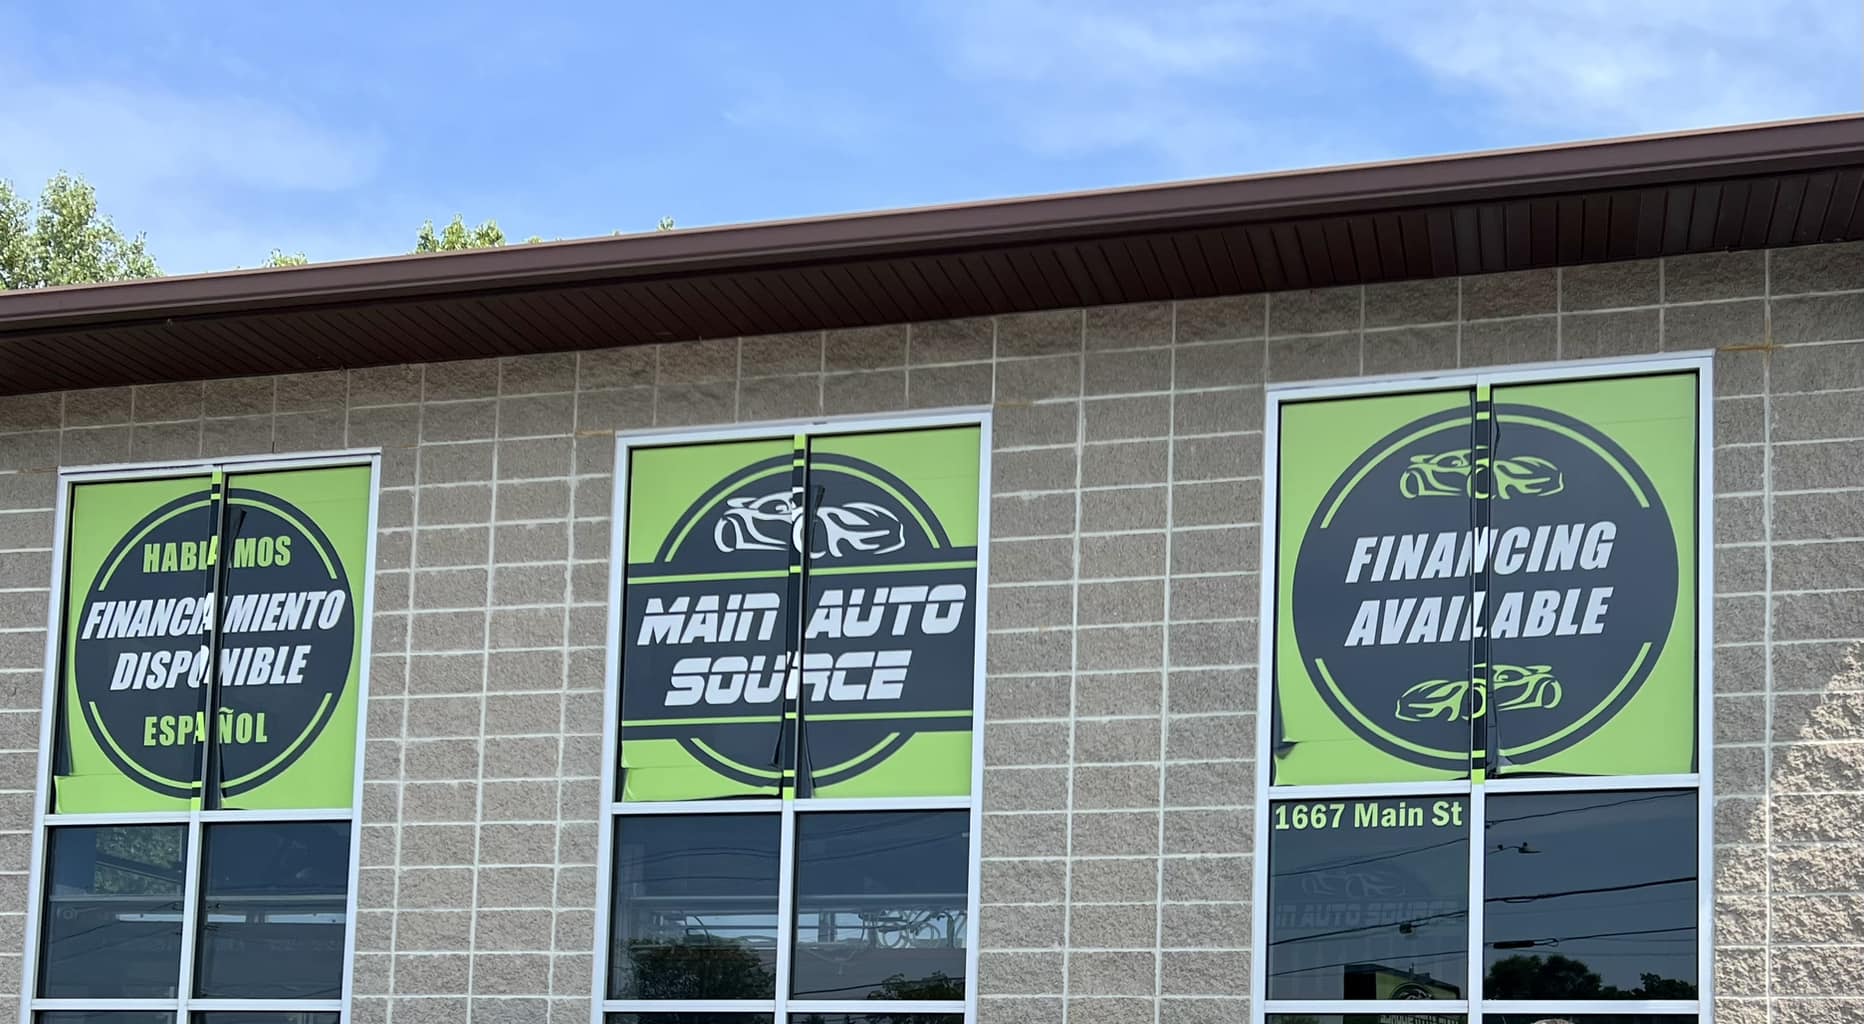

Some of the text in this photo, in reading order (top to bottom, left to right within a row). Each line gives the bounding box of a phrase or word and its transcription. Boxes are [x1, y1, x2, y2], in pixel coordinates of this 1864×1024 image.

[143, 535, 291, 573] HABLAMOS
[1344, 521, 1617, 584] FINANCING
[81, 589, 346, 641] FINANCIAMIENTO
[636, 584, 967, 646] MAIN AUTO
[1343, 586, 1614, 647] AVAILABLE
[110, 644, 311, 691] DISPONIBLE
[664, 650, 912, 707] SOURCE
[143, 707, 268, 746] ESPAÑOL
[1275, 800, 1463, 830] 1667 Main St
